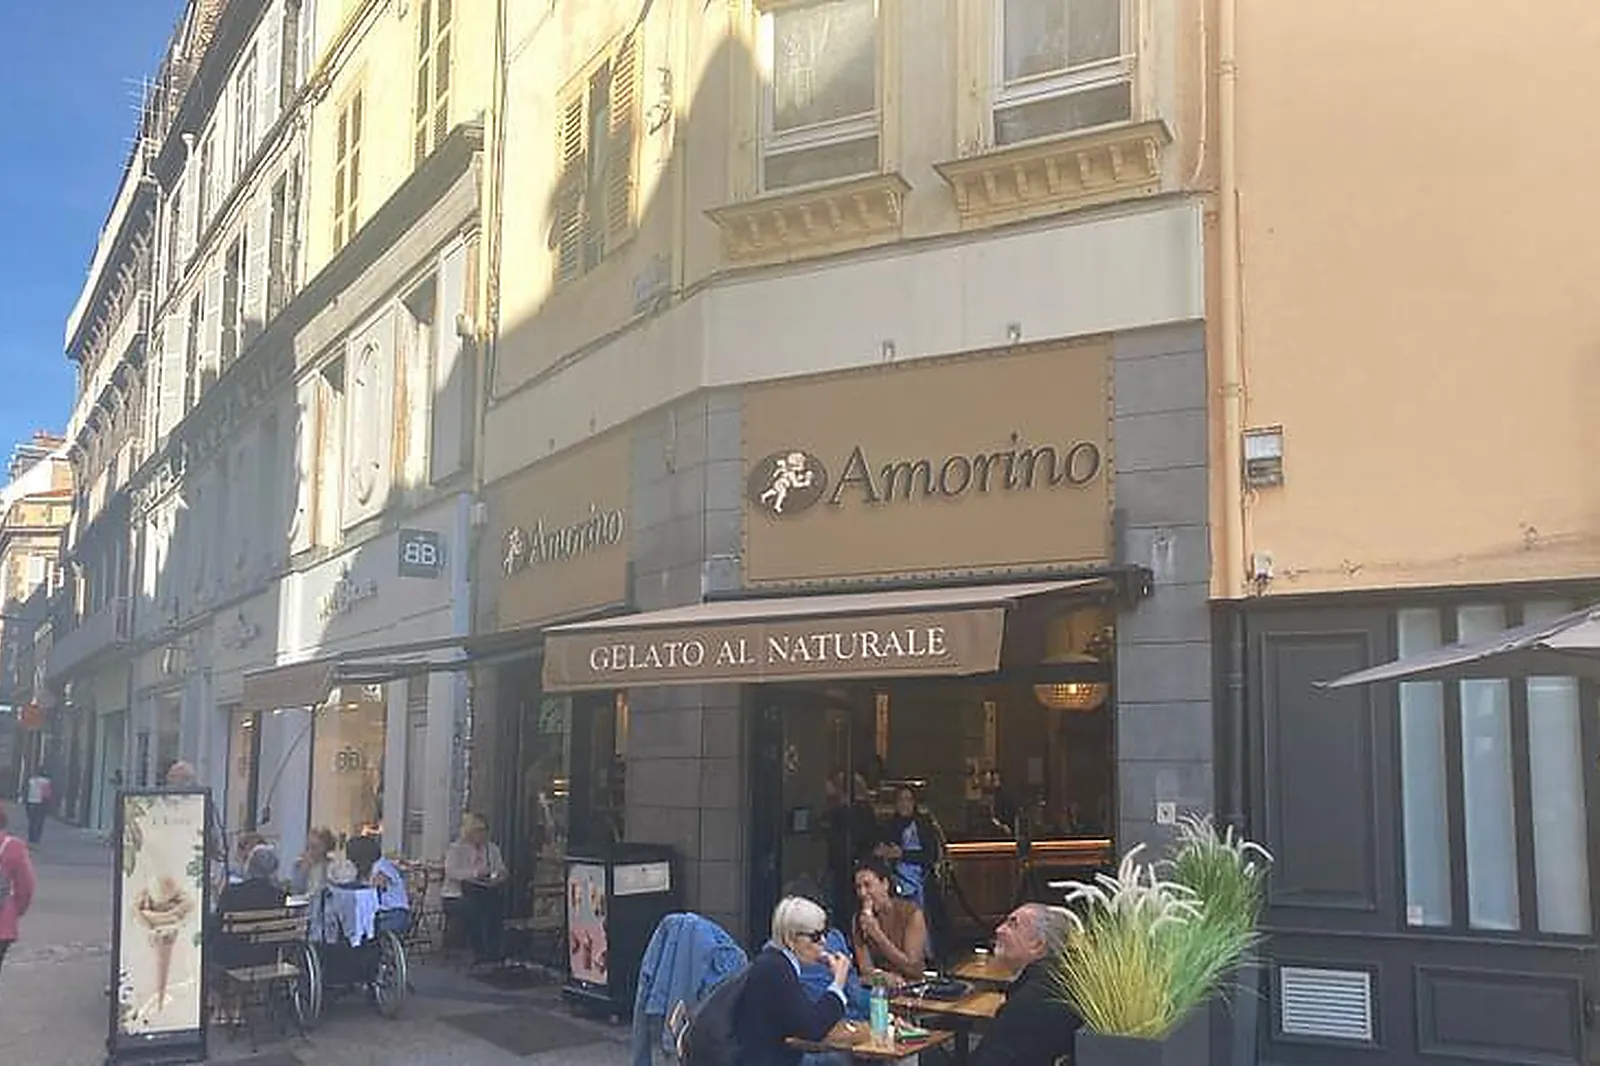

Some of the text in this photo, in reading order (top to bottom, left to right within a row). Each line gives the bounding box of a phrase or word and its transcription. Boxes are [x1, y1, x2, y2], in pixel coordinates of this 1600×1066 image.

[827, 431, 1102, 508] Amorino
[529, 502, 625, 565] Amorino
[589, 627, 947, 672] GELATO AL NATURALE
